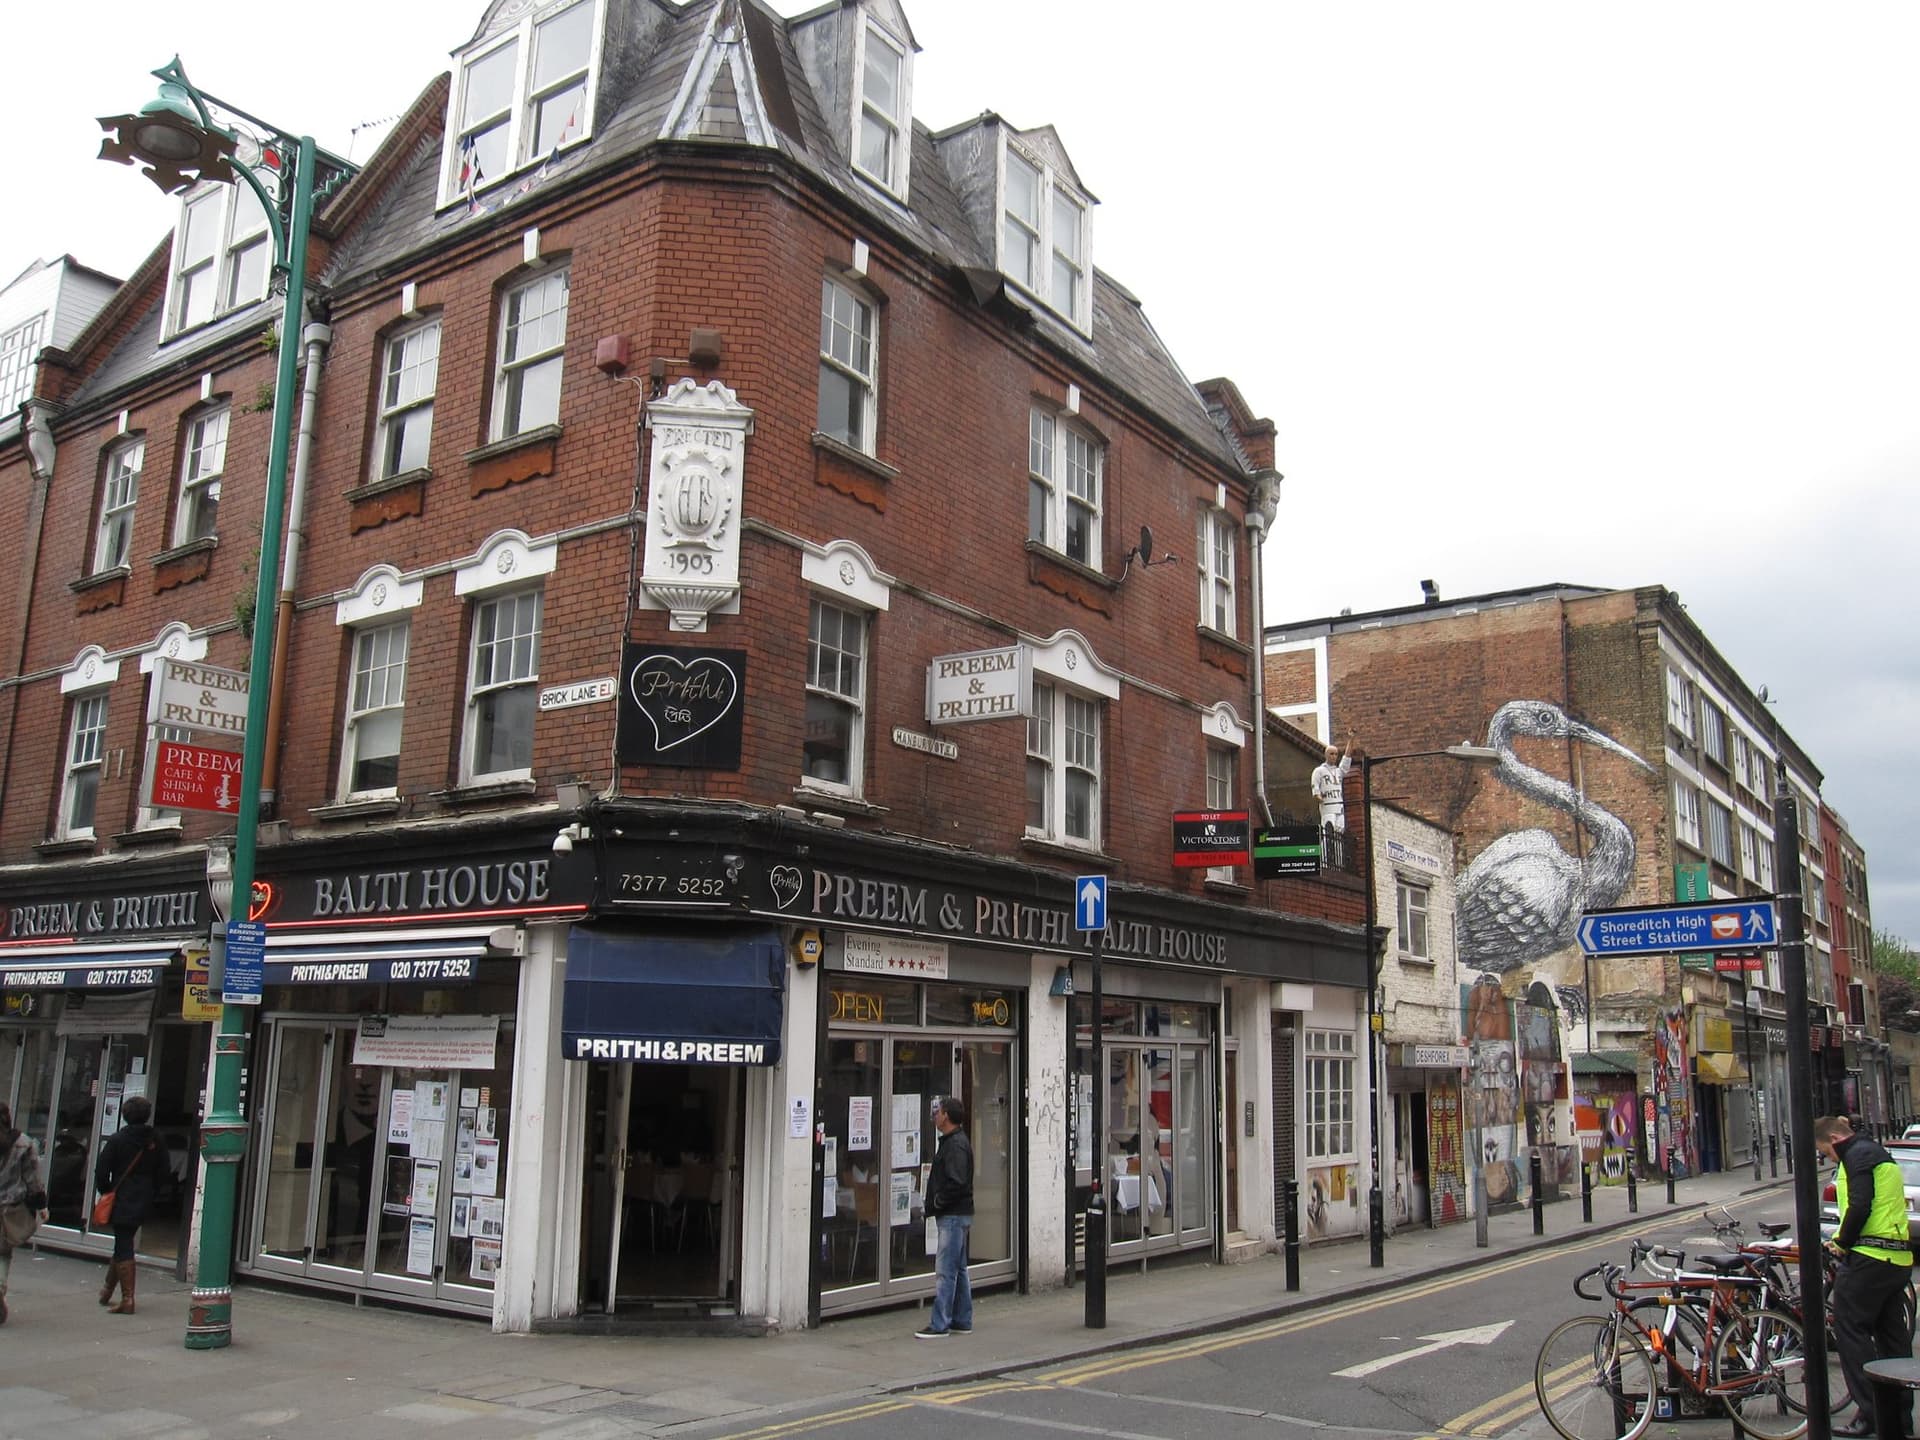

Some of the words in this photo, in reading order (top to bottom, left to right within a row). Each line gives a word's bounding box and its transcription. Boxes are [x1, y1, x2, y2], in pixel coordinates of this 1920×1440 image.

[662, 428, 733, 450] ERECTED
[669, 552, 713, 575] 1903
[938, 652, 1016, 679] PREEM
[168, 663, 250, 694] PREEM
[968, 678, 985, 696] &
[200, 690, 218, 708] &
[542, 690, 568, 706] BRICK
[571, 685, 597, 702] LANE
[164, 702, 248, 733] PRITHI
[937, 694, 1015, 720] PRITHI
[896, 730, 933, 753] HANBURY
[165, 747, 243, 774] PREEM
[164, 767, 193, 781] CAFE
[197, 772, 208, 782] &
[161, 791, 185, 804] BAR
[162, 779, 204, 794] SHISHA
[1181, 835, 1241, 846] VICTORSTONE
[313, 871, 411, 917] BALTI
[419, 859, 551, 910] HOUSE
[619, 873, 668, 891] 7377
[677, 877, 725, 896] 5252
[8, 902, 80, 937] PREEM
[86, 900, 104, 931] &
[110, 891, 199, 930] PRITHI
[811, 869, 928, 927] PREEM
[938, 893, 964, 930] &
[974, 895, 1070, 946] PRITHI
[1083, 917, 1153, 955] ALTI
[1158, 926, 1227, 965] HOUSE
[1600, 917, 1670, 934] Shoreditch
[1675, 915, 1706, 930] High
[846, 936, 882, 956] Evening
[1601, 931, 1642, 947] Street
[1649, 931, 1697, 944] Station
[291, 963, 369, 981] PRITHI&PREEM
[390, 962, 411, 979] 020
[412, 960, 440, 978] 7377
[441, 958, 471, 978] 5252
[846, 954, 884, 970] Standard
[3, 971, 66, 986] PRITHI&PREEM
[86, 972, 104, 985] 020
[104, 970, 130, 984] 7377
[130, 969, 154, 983] 5252
[189, 985, 209, 997] Cas
[201, 1003, 218, 1013] Here
[831, 991, 883, 1022] OPEN
[576, 1037, 765, 1064] PRITHI&PREEM
